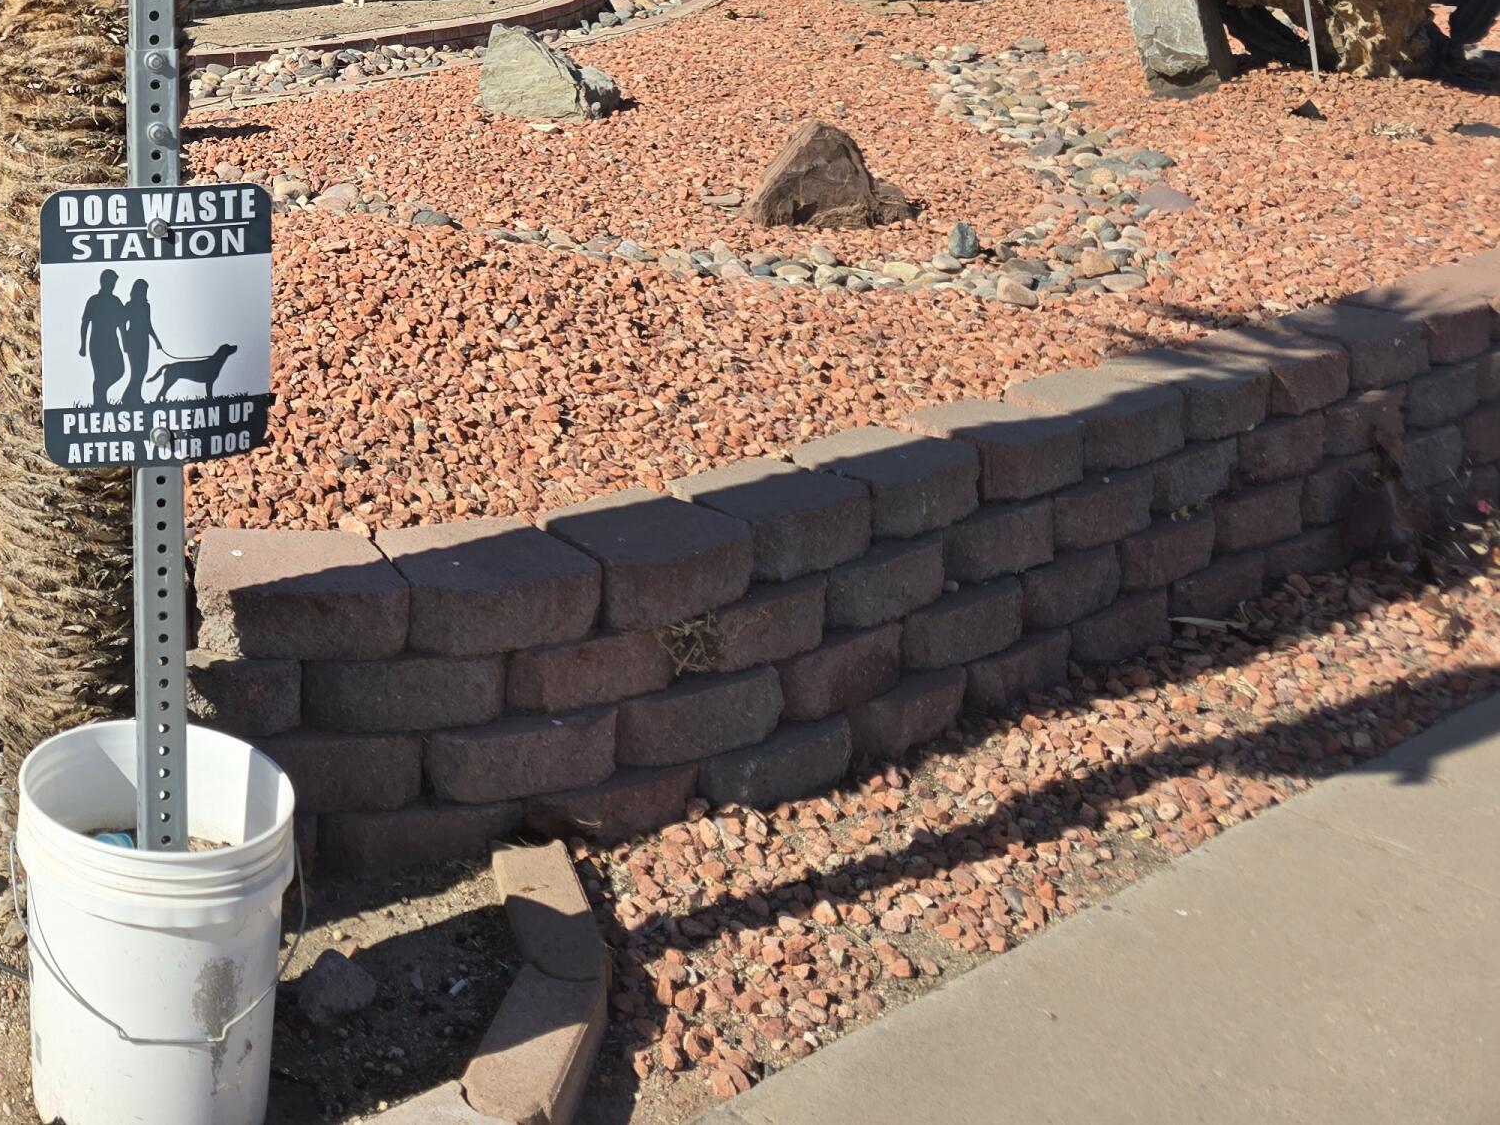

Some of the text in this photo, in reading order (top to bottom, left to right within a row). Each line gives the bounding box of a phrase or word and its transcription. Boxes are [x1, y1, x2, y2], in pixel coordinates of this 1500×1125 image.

[59, 189, 256, 226] DOG WASTE
[72, 228, 245, 260] STATION
[63, 402, 254, 435] PLEASE CLEAN UP
[68, 431, 250, 464] AFTER YOUR DOG
